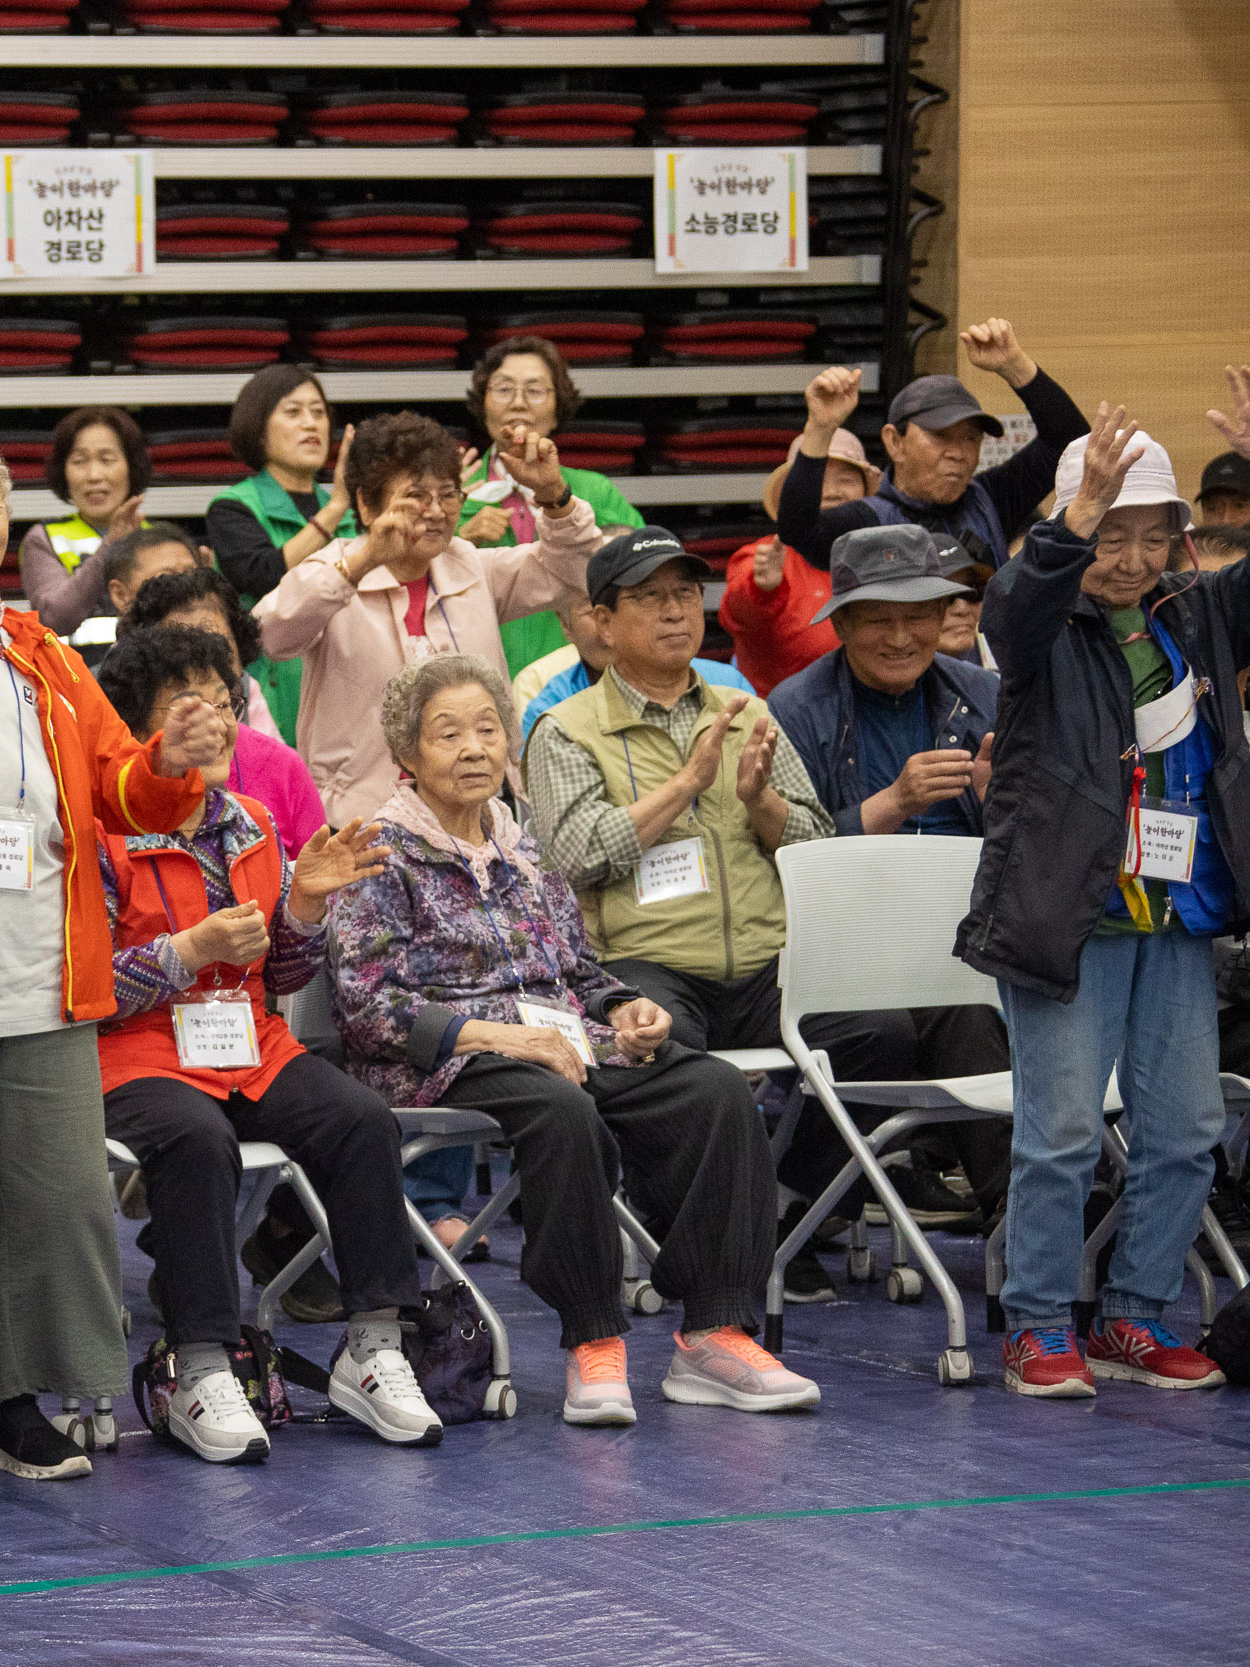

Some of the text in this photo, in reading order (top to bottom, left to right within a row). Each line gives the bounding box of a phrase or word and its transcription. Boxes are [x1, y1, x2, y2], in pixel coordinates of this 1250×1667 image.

[43, 206, 105, 232] 아차산
[684, 210, 780, 235] 소능경로당
[44, 238, 106, 264] 경로당
